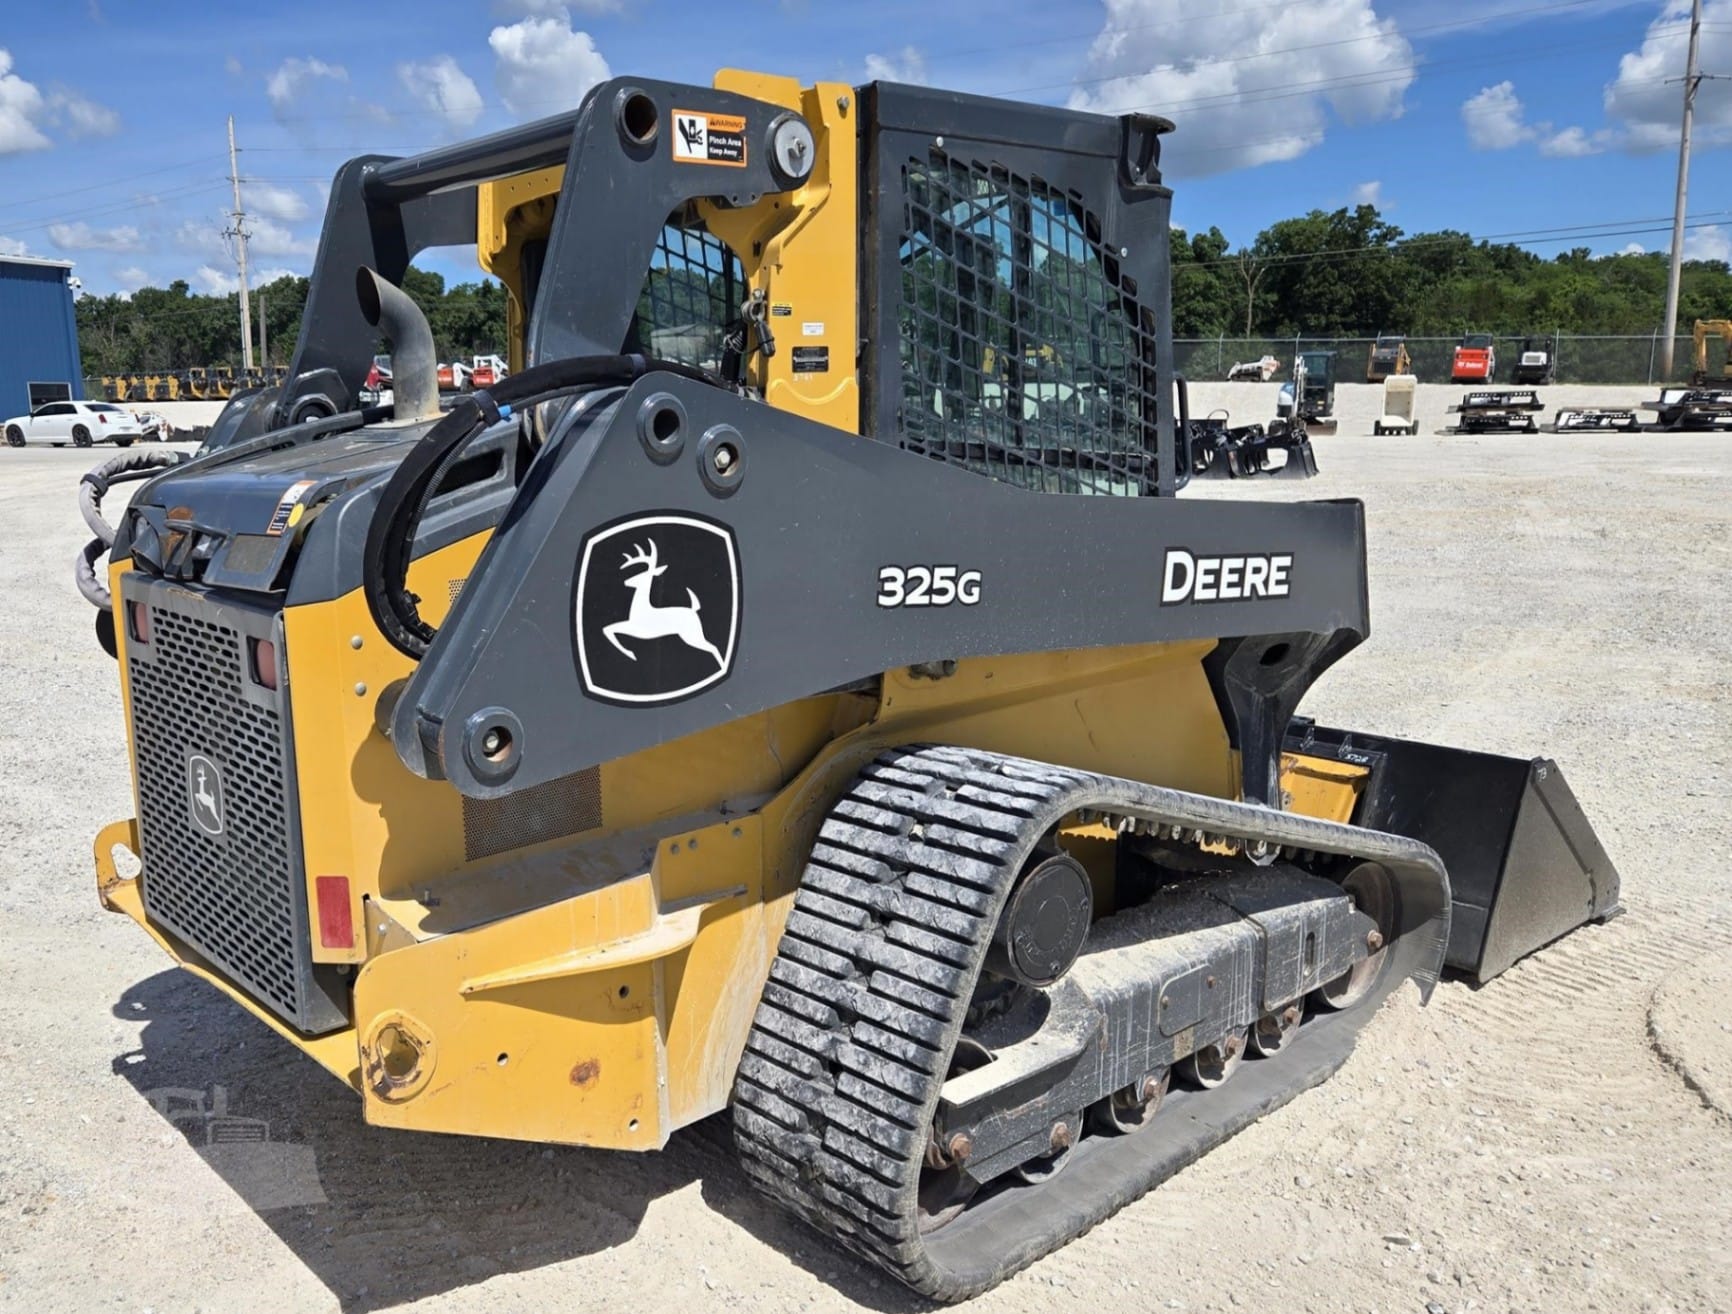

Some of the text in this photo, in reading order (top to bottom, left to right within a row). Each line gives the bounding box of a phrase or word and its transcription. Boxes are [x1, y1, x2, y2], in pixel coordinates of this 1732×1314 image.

[709, 135, 742, 147] Pinch Area
[709, 146, 738, 157] Keep Away
[877, 566, 981, 607] 325G
[1161, 549, 1292, 604] DEERE
